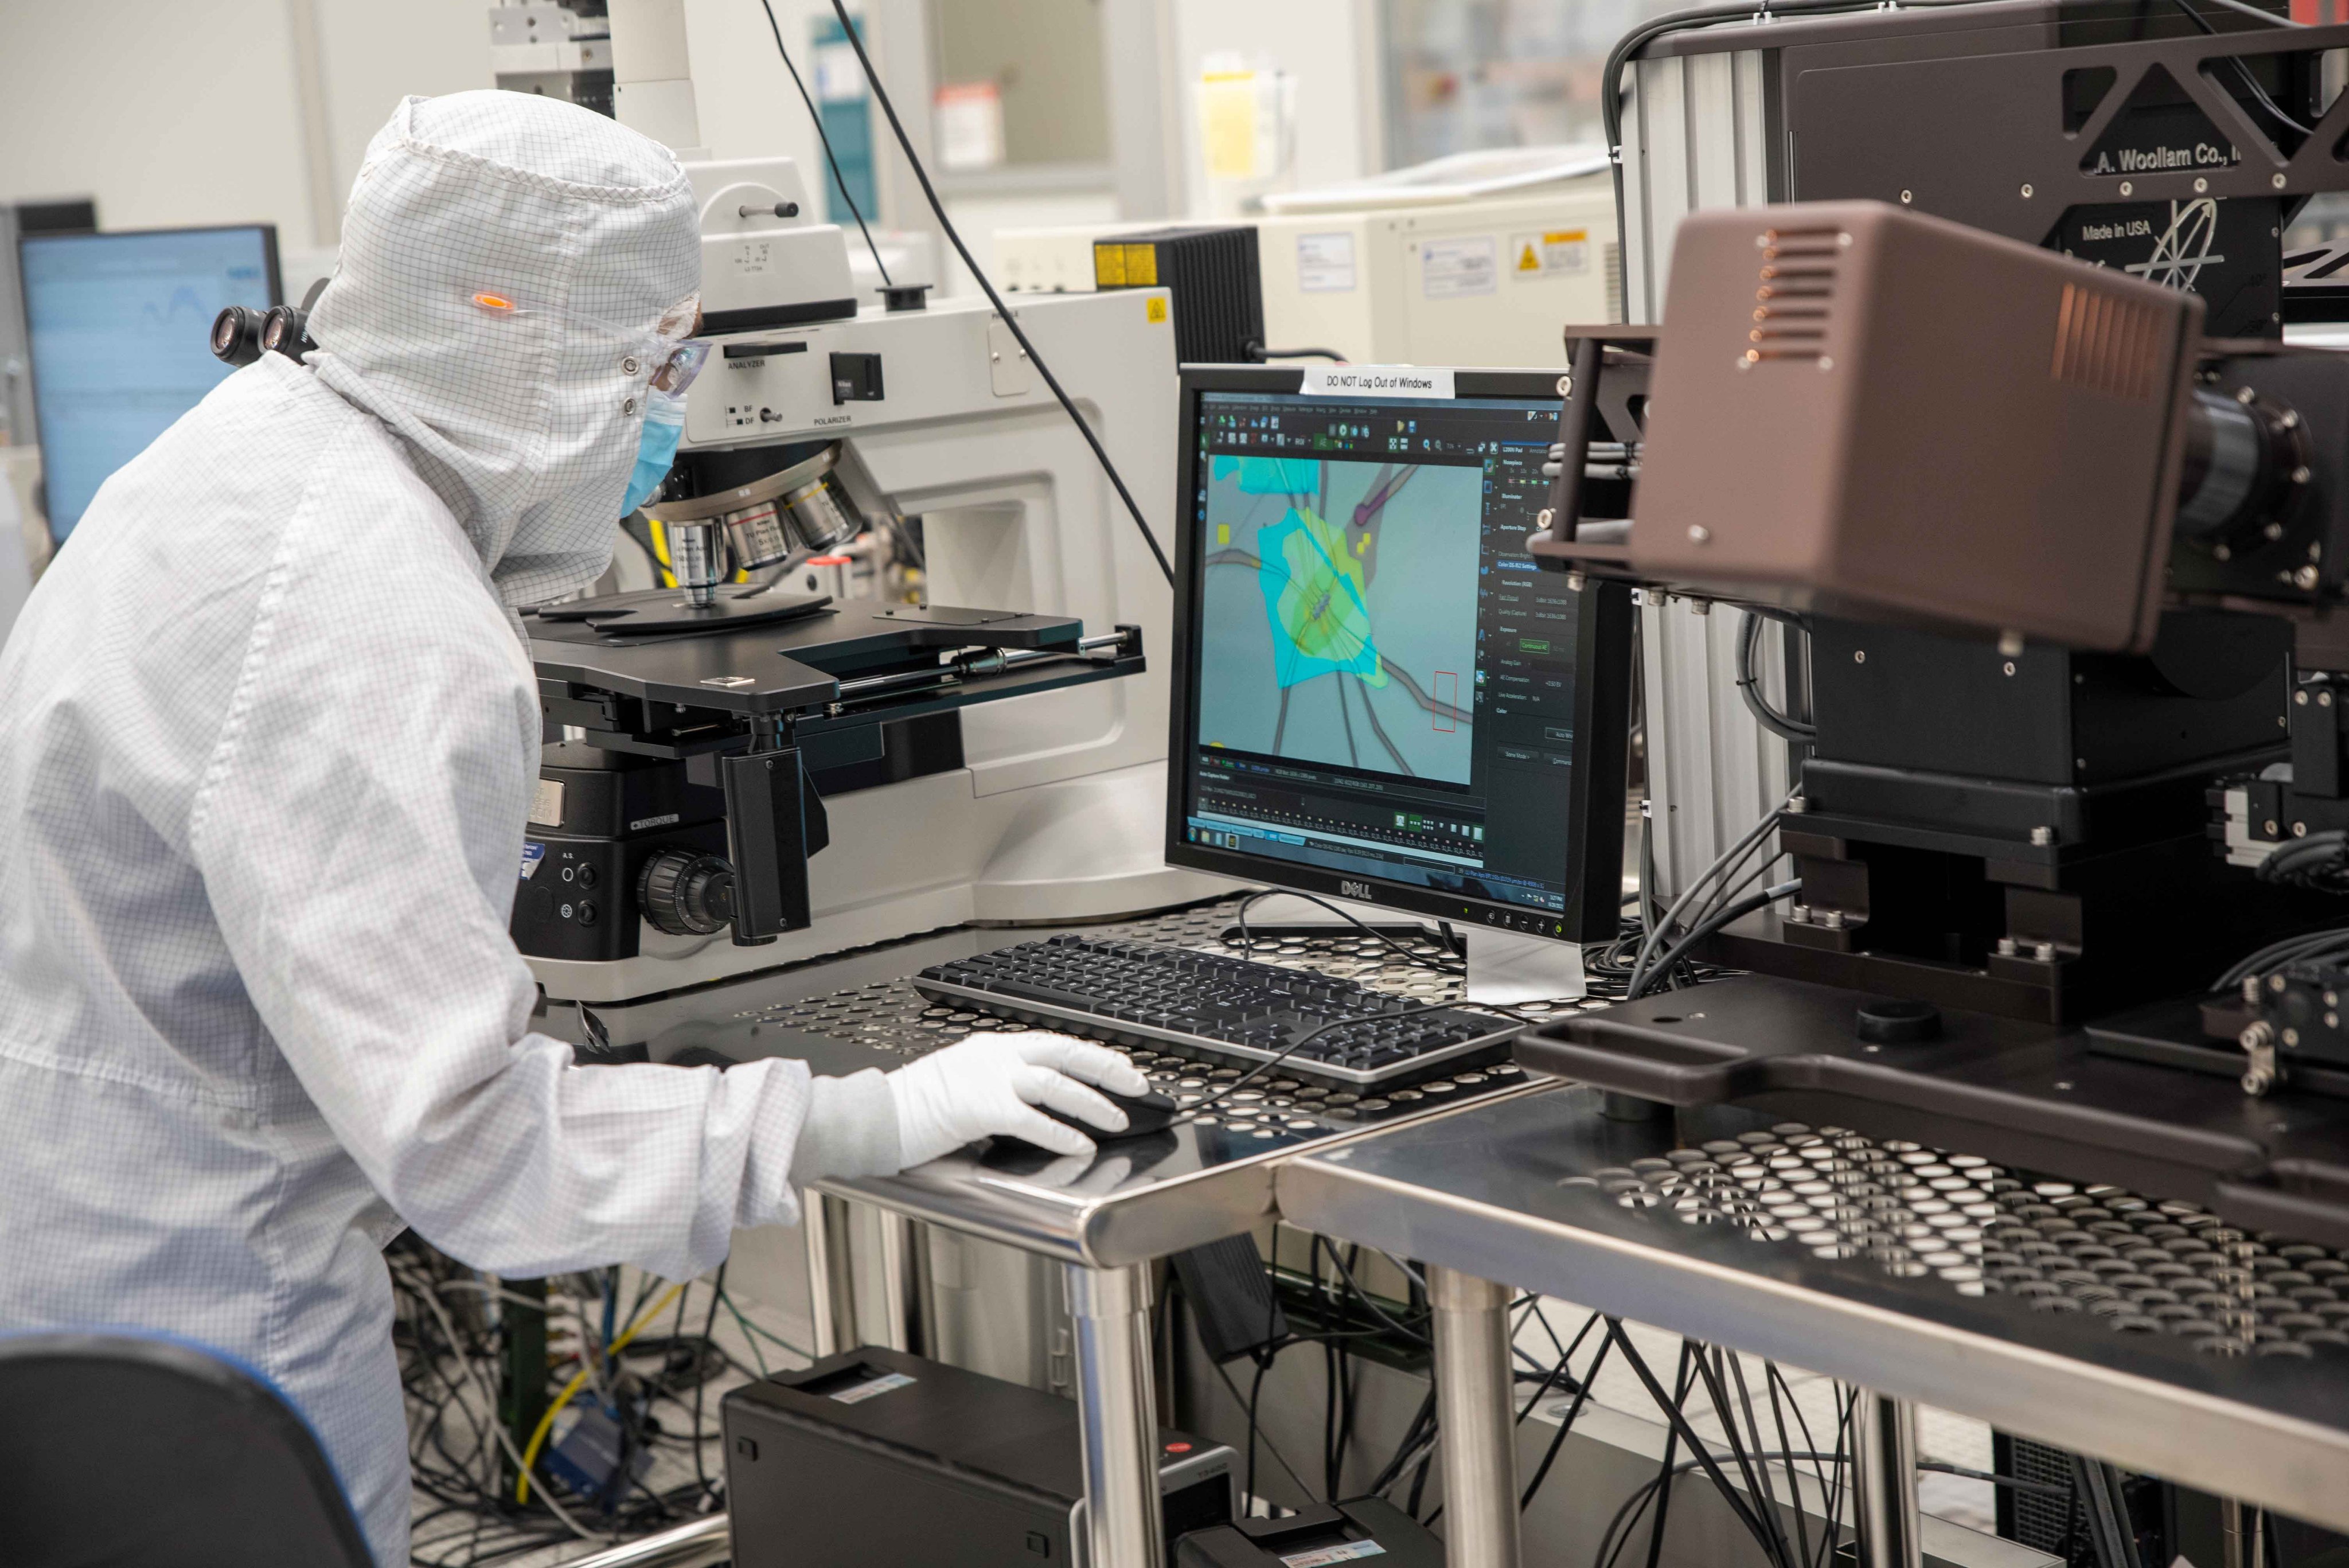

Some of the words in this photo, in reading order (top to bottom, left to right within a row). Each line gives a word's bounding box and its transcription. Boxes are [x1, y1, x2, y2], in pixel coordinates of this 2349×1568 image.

[2118, 146, 2192, 171] Woollam
[2195, 142, 2227, 166] Co.,
[2231, 145, 2241, 161] I
[2082, 224, 2113, 240] Made
[2114, 223, 2125, 237] in
[2126, 220, 2152, 236] USA
[728, 360, 766, 370] ANALYZER
[1327, 376, 1339, 386] DO
[1341, 376, 1357, 387] NOT
[1359, 376, 1372, 389] Log
[1375, 376, 1388, 388] Out
[1390, 377, 1398, 388] of
[1399, 377, 1433, 389] Windows
[746, 417, 755, 425] DF
[814, 416, 852, 426] POLARIZER
[639, 814, 674, 828] TORQUE
[1341, 880, 1372, 900] DELL
